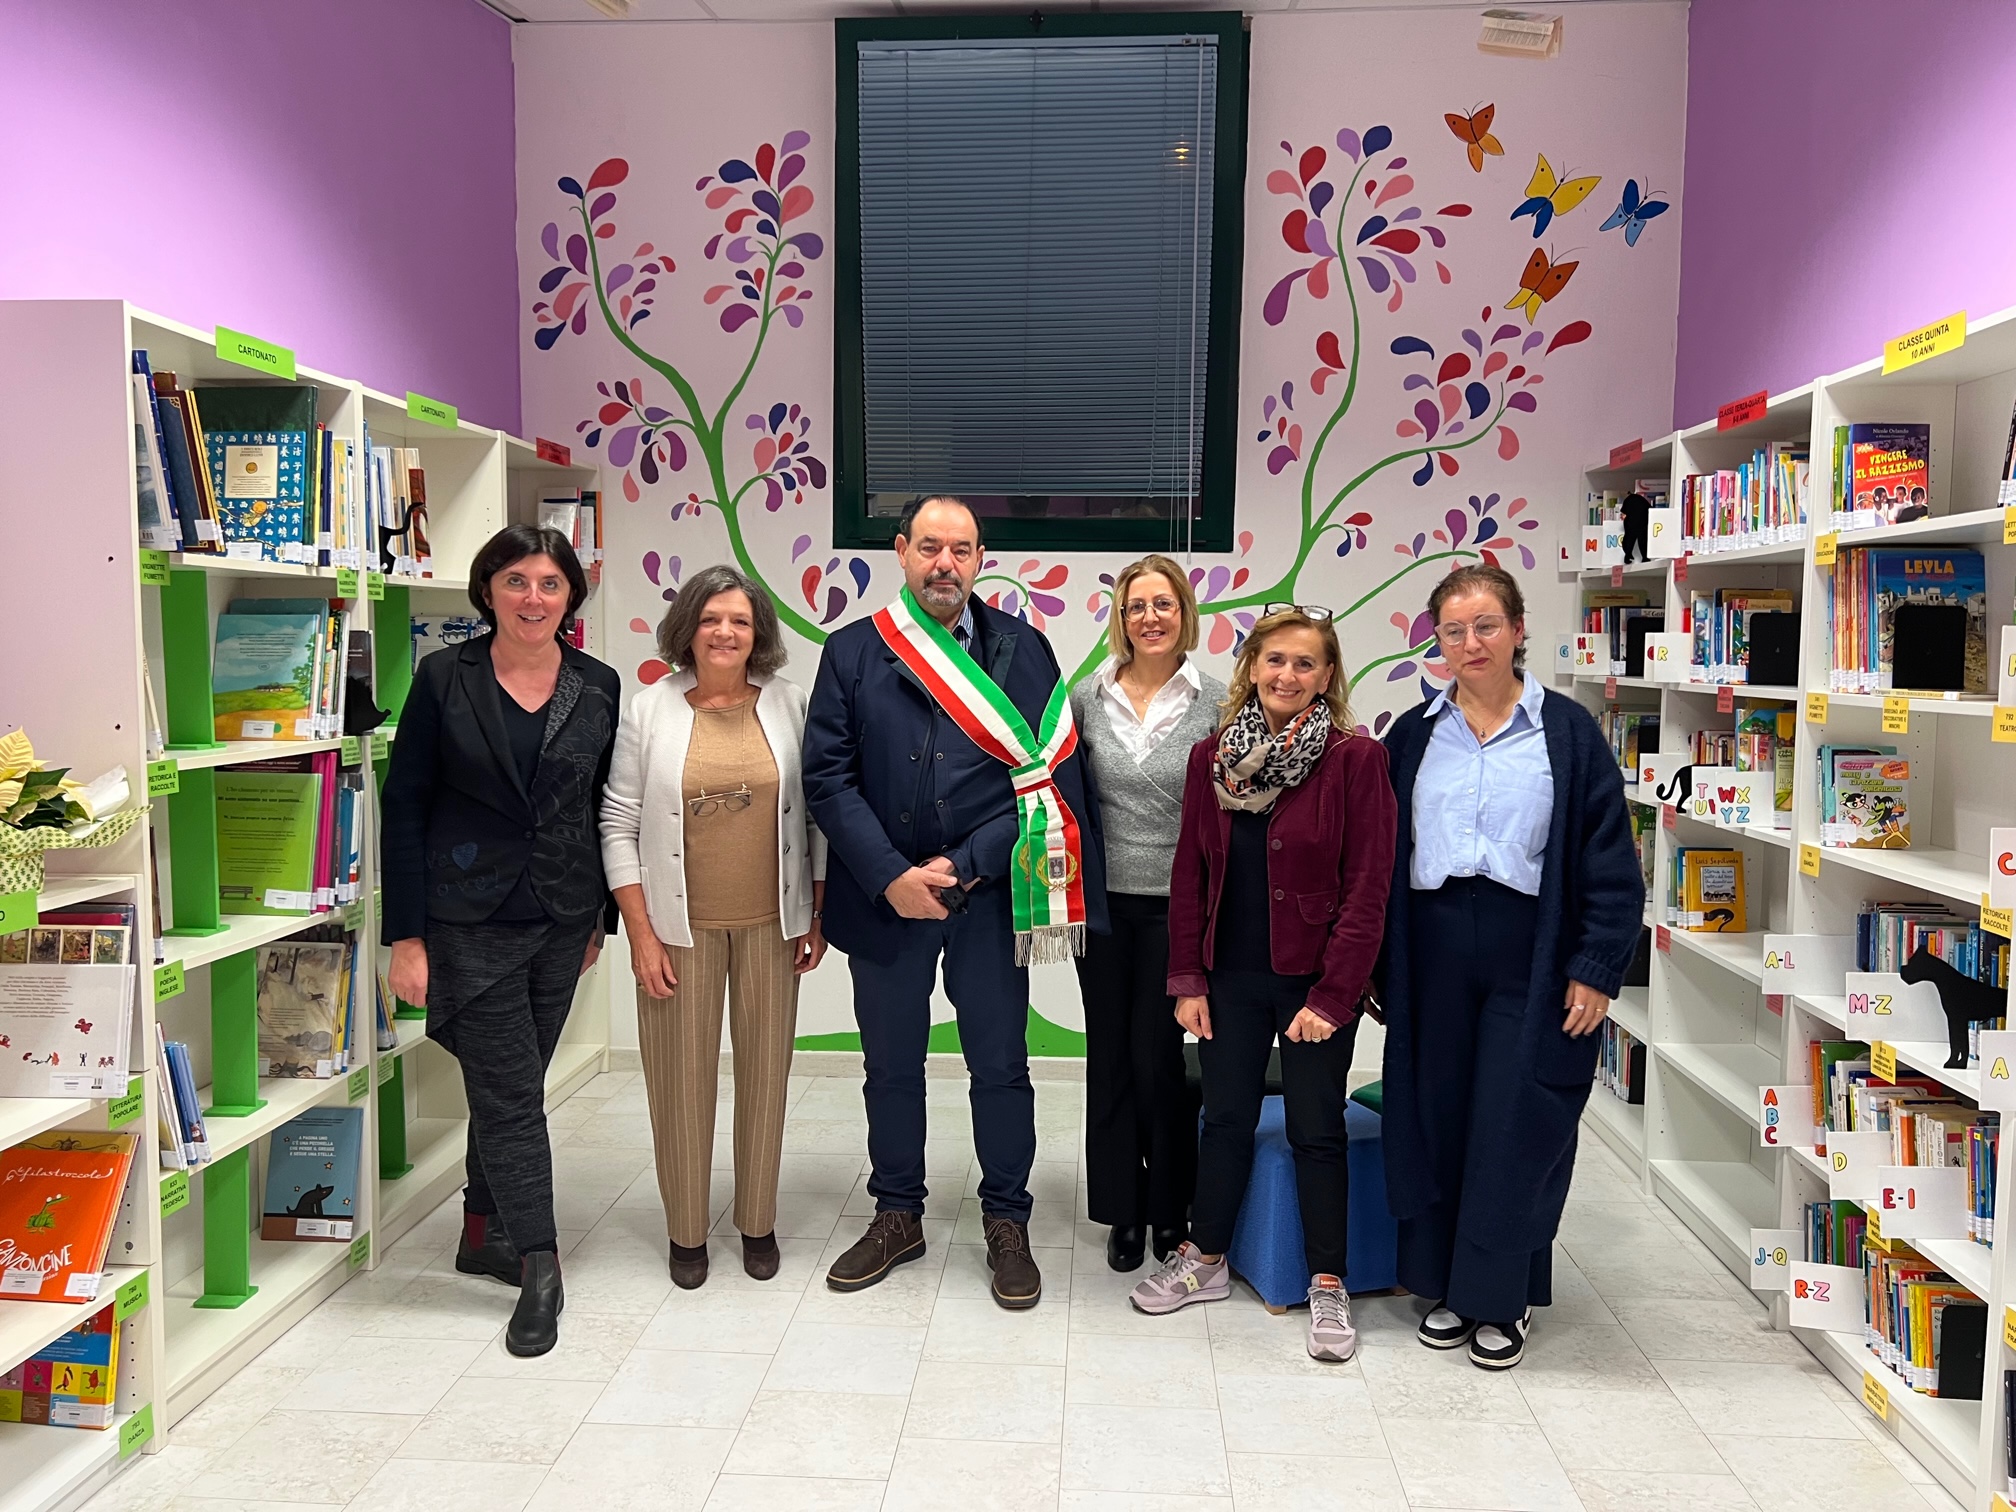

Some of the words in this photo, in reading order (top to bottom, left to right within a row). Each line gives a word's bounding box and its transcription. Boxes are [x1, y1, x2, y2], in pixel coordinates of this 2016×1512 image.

[1898, 333, 1924, 352] CLASSE
[1924, 323, 1950, 342] QUINTA
[237, 344, 278, 365] CARTONATO
[1911, 349, 1918, 360] 10
[1919, 342, 1936, 358] ANNI
[420, 404, 446, 420] CARTONATO
[1719, 406, 1734, 418] CLASSE
[1870, 450, 1908, 465] VINCERE
[1855, 470, 1867, 480] IL
[1869, 459, 1926, 478] RAZZISMO
[1652, 522, 1663, 538] P
[1561, 547, 1568, 559] L
[1586, 539, 1598, 552] M
[1904, 560, 1954, 574] LEYLA
[1560, 645, 1568, 658] G
[1657, 646, 1668, 662] R
[148, 774, 172, 784] RETORICA
[1644, 768, 1655, 782] S
[150, 782, 176, 792] RACCOLTE
[1696, 783, 1708, 798] T
[1998, 852, 2016, 876] C
[1982, 908, 2006, 920] RETORICA
[1983, 918, 2008, 932] RACCOLTE
[1765, 950, 1795, 970] A-L
[159, 984, 179, 996] INGLESE
[160, 976, 177, 987] POESIA
[1849, 994, 1893, 1015] M-Z
[1990, 1057, 2010, 1080] A
[110, 1094, 142, 1114] LETTERATURA
[1764, 1088, 1778, 1106] A
[114, 1104, 139, 1121] POPOLARE
[1765, 1107, 1780, 1126] B
[1764, 1126, 1778, 1144] C
[1832, 1152, 1848, 1172] D
[161, 1184, 187, 1203] NARRATIVA
[162, 1194, 185, 1209] TEDESCA
[1883, 1188, 1916, 1210] E-I
[1754, 1247, 1787, 1266] J-Q
[1794, 1279, 1830, 1302] R-Z
[123, 1292, 142, 1309] MUSICA
[1865, 1383, 1885, 1405] NARRATIVA
[1867, 1394, 1882, 1412] INGLESE
[128, 1428, 145, 1444] DANZA
